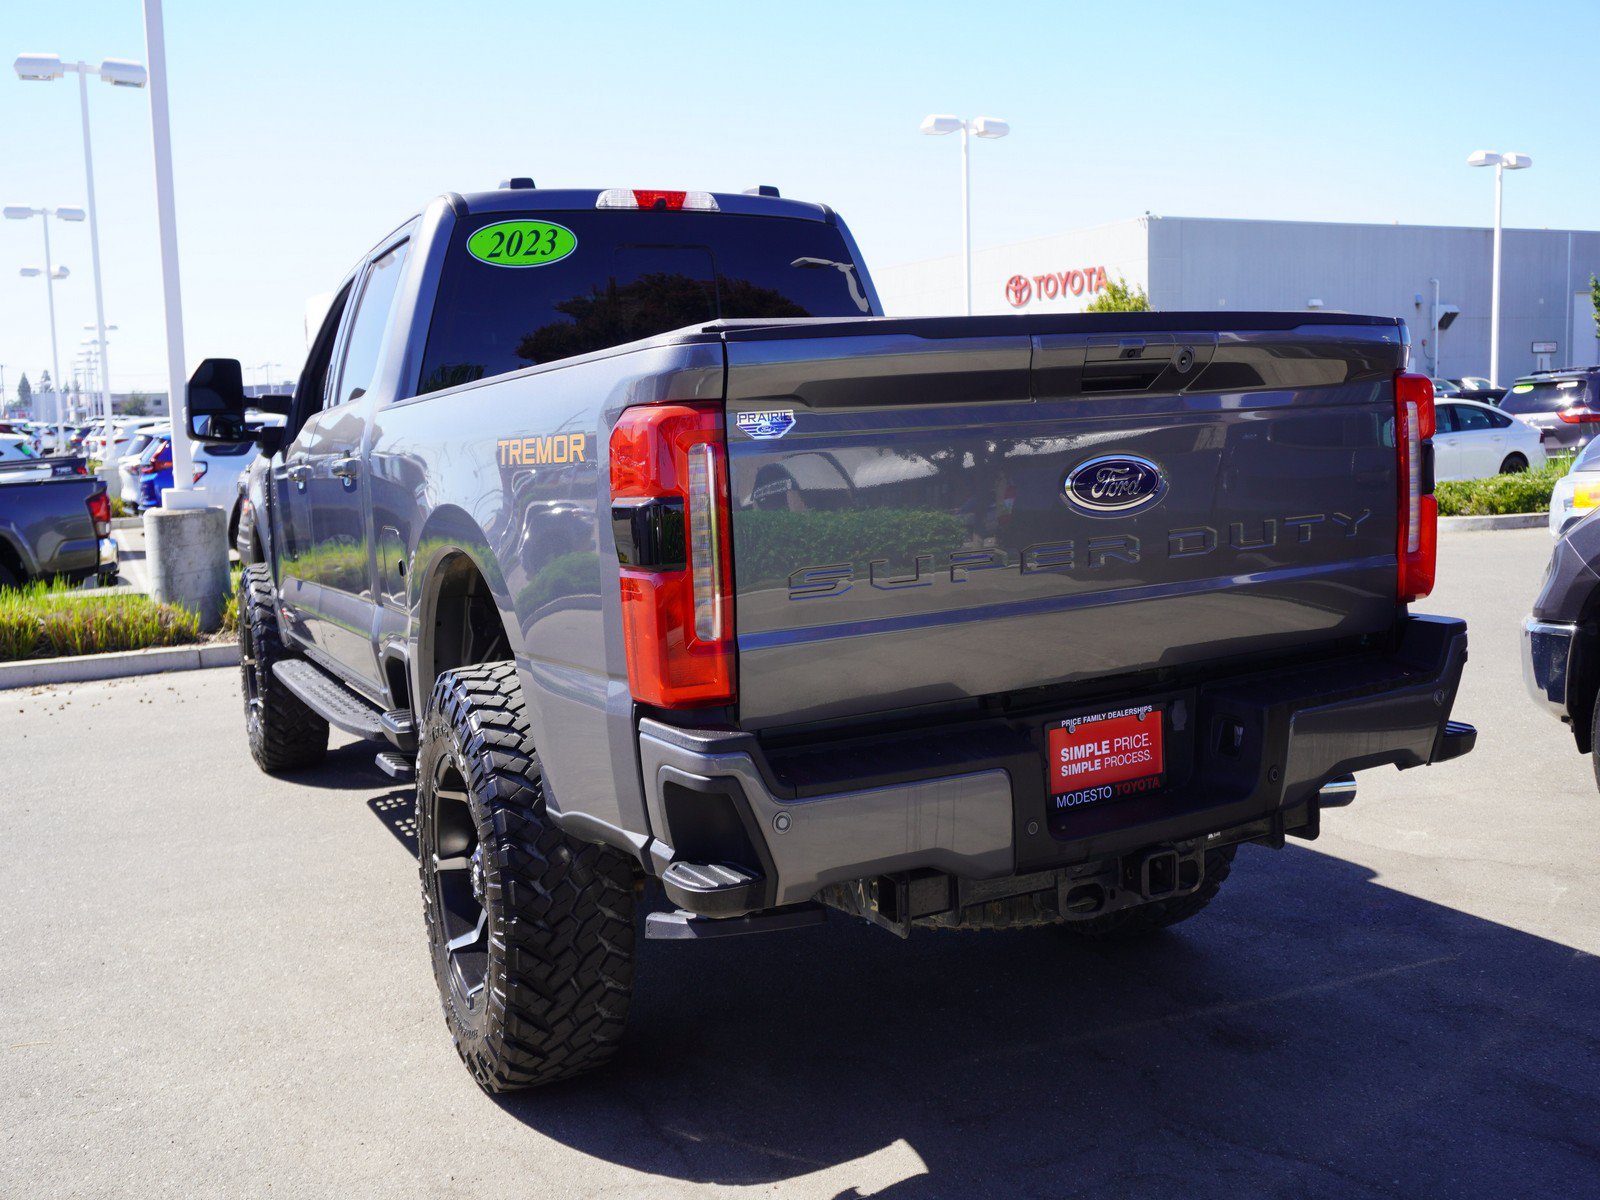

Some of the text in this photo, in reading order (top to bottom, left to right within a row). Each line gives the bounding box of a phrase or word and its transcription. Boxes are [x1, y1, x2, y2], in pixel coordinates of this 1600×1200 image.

[487, 229, 558, 258] 2023
[1033, 266, 1107, 299] TOYOTA
[738, 411, 792, 424] PRAIRIE
[497, 434, 585, 465] TREMOR
[1091, 467, 1143, 499] Ford
[788, 508, 1371, 600] SUPER DUTY
[1061, 705, 1153, 727] PRICE FAMILY DEALERSHIPS
[1060, 732, 1153, 762] SIMPLE PRICE.
[1061, 749, 1153, 777] SIMPLE PROCESS.
[1056, 777, 1161, 808] MODESTO TOYOTA
